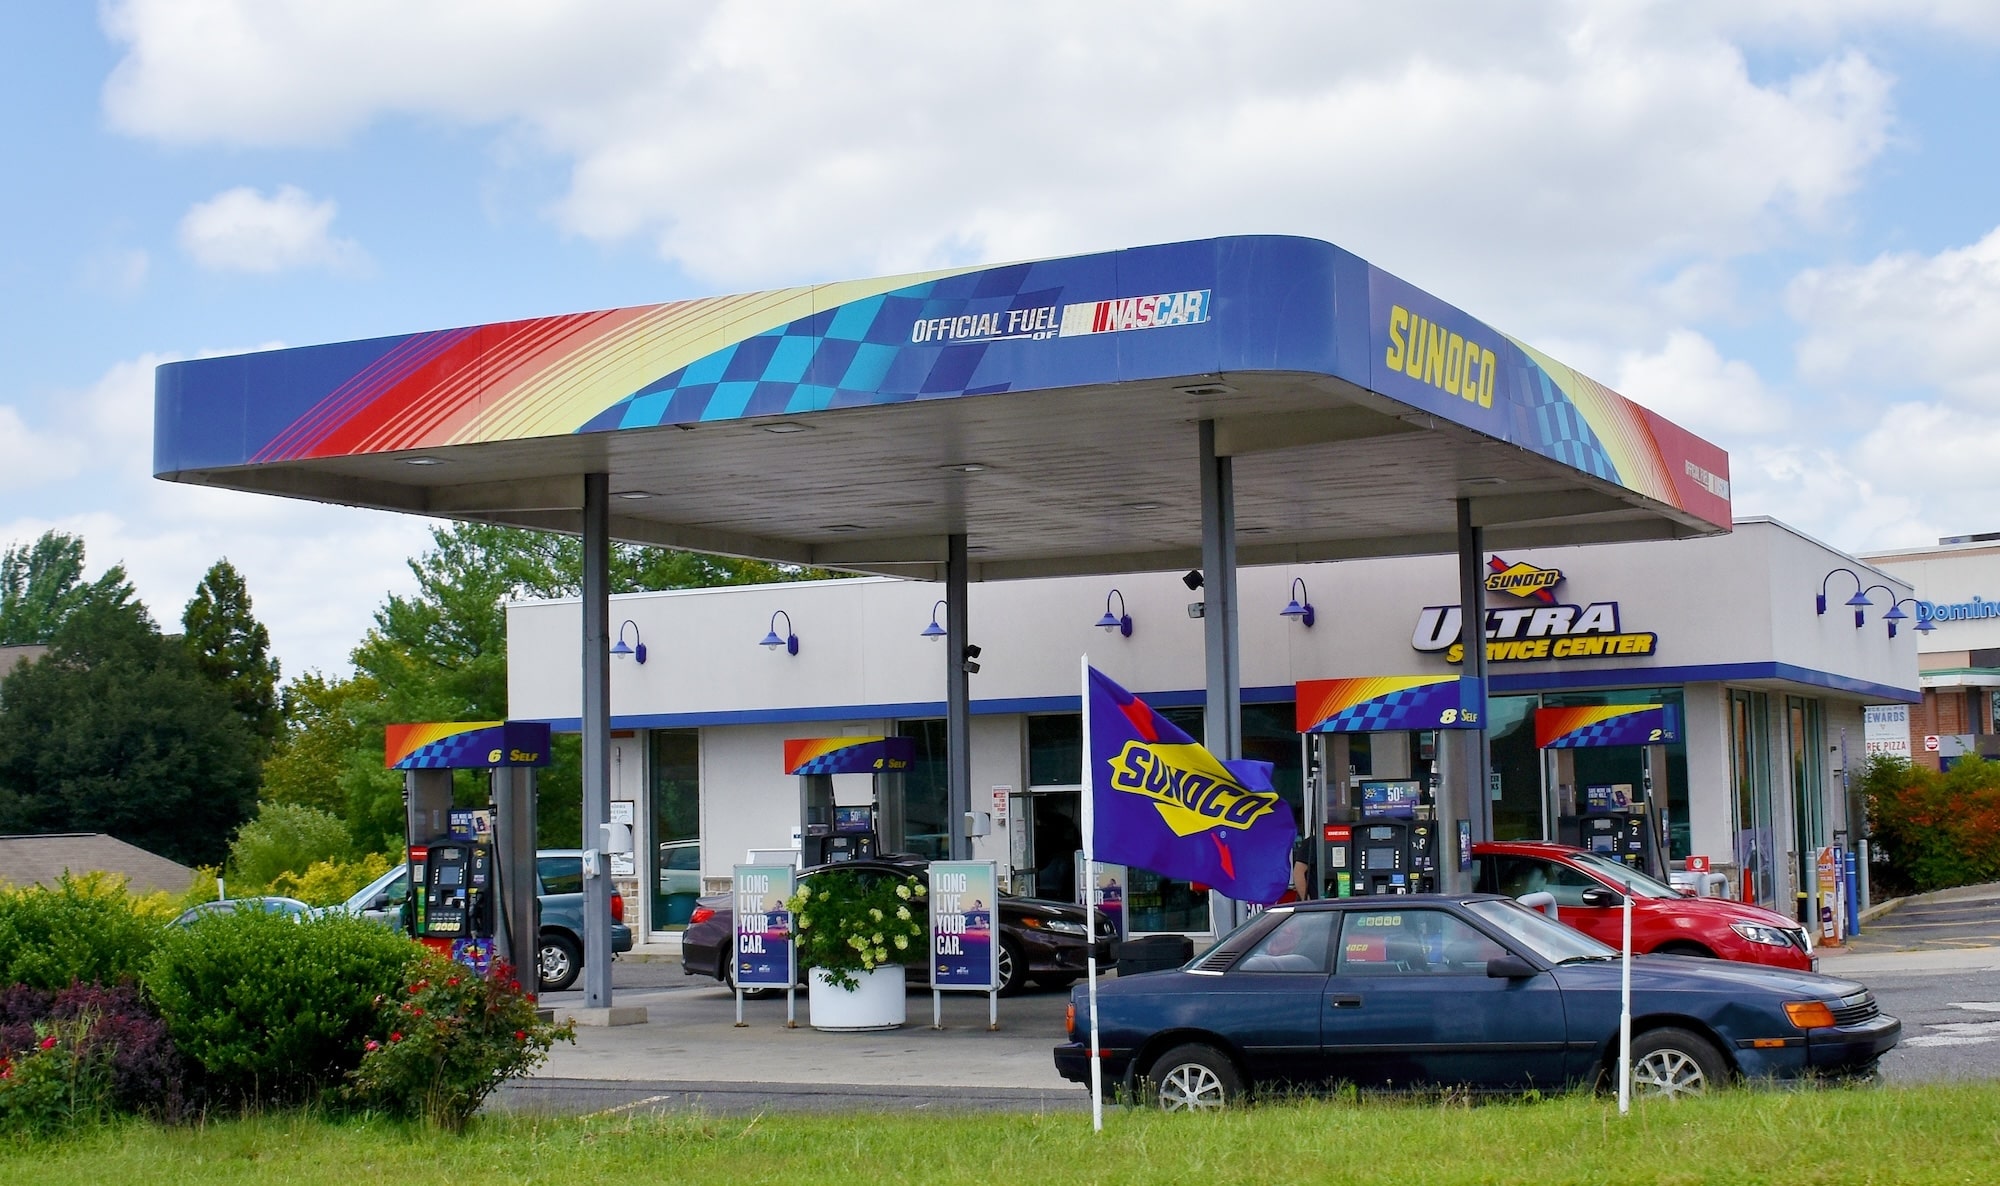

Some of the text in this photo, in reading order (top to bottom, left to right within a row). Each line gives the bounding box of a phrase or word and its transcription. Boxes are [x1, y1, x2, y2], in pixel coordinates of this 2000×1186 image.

[1105, 291, 1203, 331] NASCAR
[912, 306, 1059, 343] OFFICIAL FUEL
[1032, 331, 1058, 342] OF
[1386, 304, 1496, 409] SUNOCO
[1488, 572, 1557, 589] SUNOCO
[1916, 597, 2000, 622] Domin
[1446, 633, 1653, 662] SRVICE CENTER
[1440, 708, 1458, 724] 8
[1866, 711, 1905, 723] EWARDS
[1648, 728, 1662, 741] 2
[1867, 741, 1906, 751] REE PIZZA
[488, 749, 502, 763] 6
[872, 758, 884, 769] 4
[1118, 747, 1273, 824] SUNOCO
[1631, 827, 1638, 836] 2
[862, 845, 867, 853] 4
[476, 858, 482, 869] 6
[740, 874, 769, 893] LONG
[936, 873, 967, 892] LONG
[1080, 874, 1101, 889] LE
[740, 894, 764, 913] LIVE
[936, 893, 961, 913] LIVE
[1080, 889, 1104, 905] YUR
[740, 914, 769, 933] YOUR
[936, 914, 966, 934] YOUR
[740, 934, 766, 954] CAR.
[936, 935, 964, 955] CAR.
